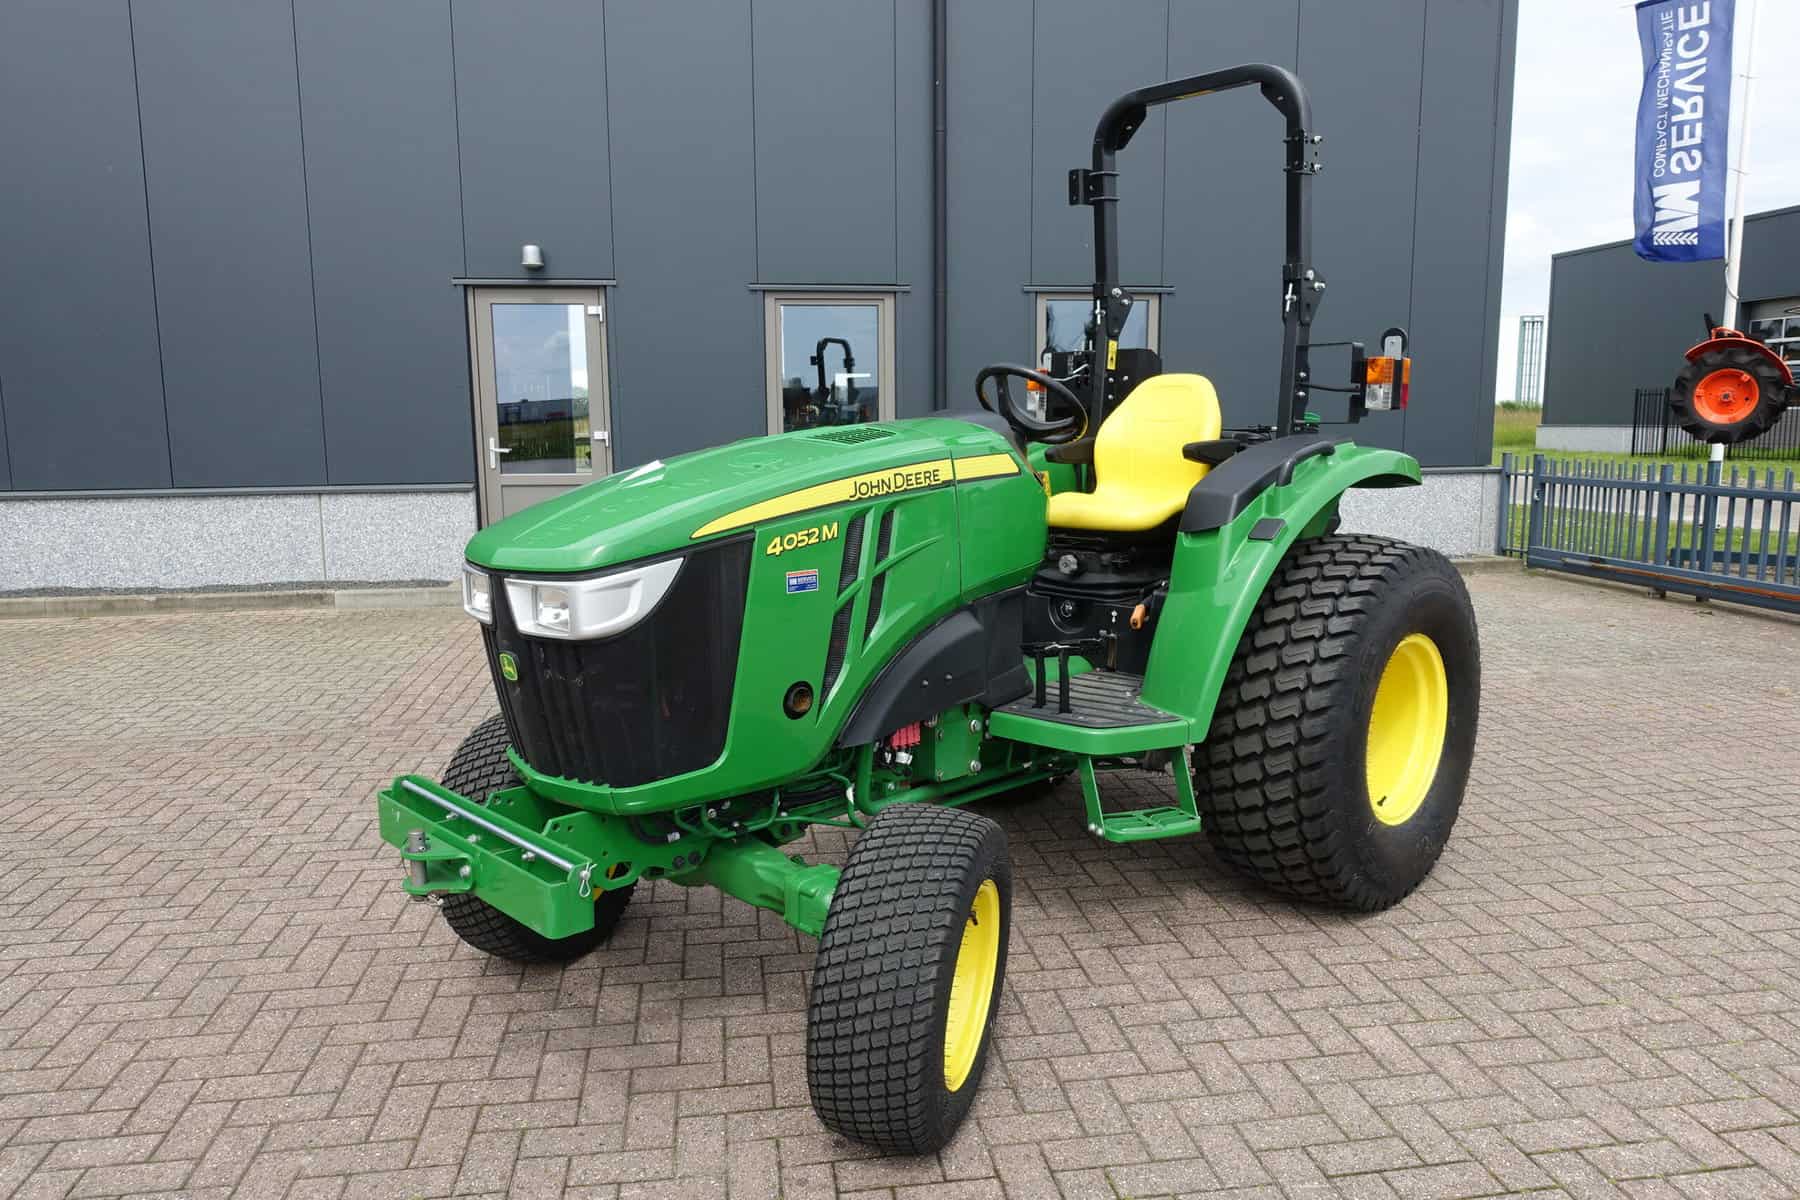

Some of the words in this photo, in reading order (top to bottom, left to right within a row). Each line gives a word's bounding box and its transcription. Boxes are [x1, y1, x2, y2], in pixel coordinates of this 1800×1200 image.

[849, 477, 891, 498] JOHN
[893, 469, 941, 489] DEERE
[766, 527, 820, 556] 4052
